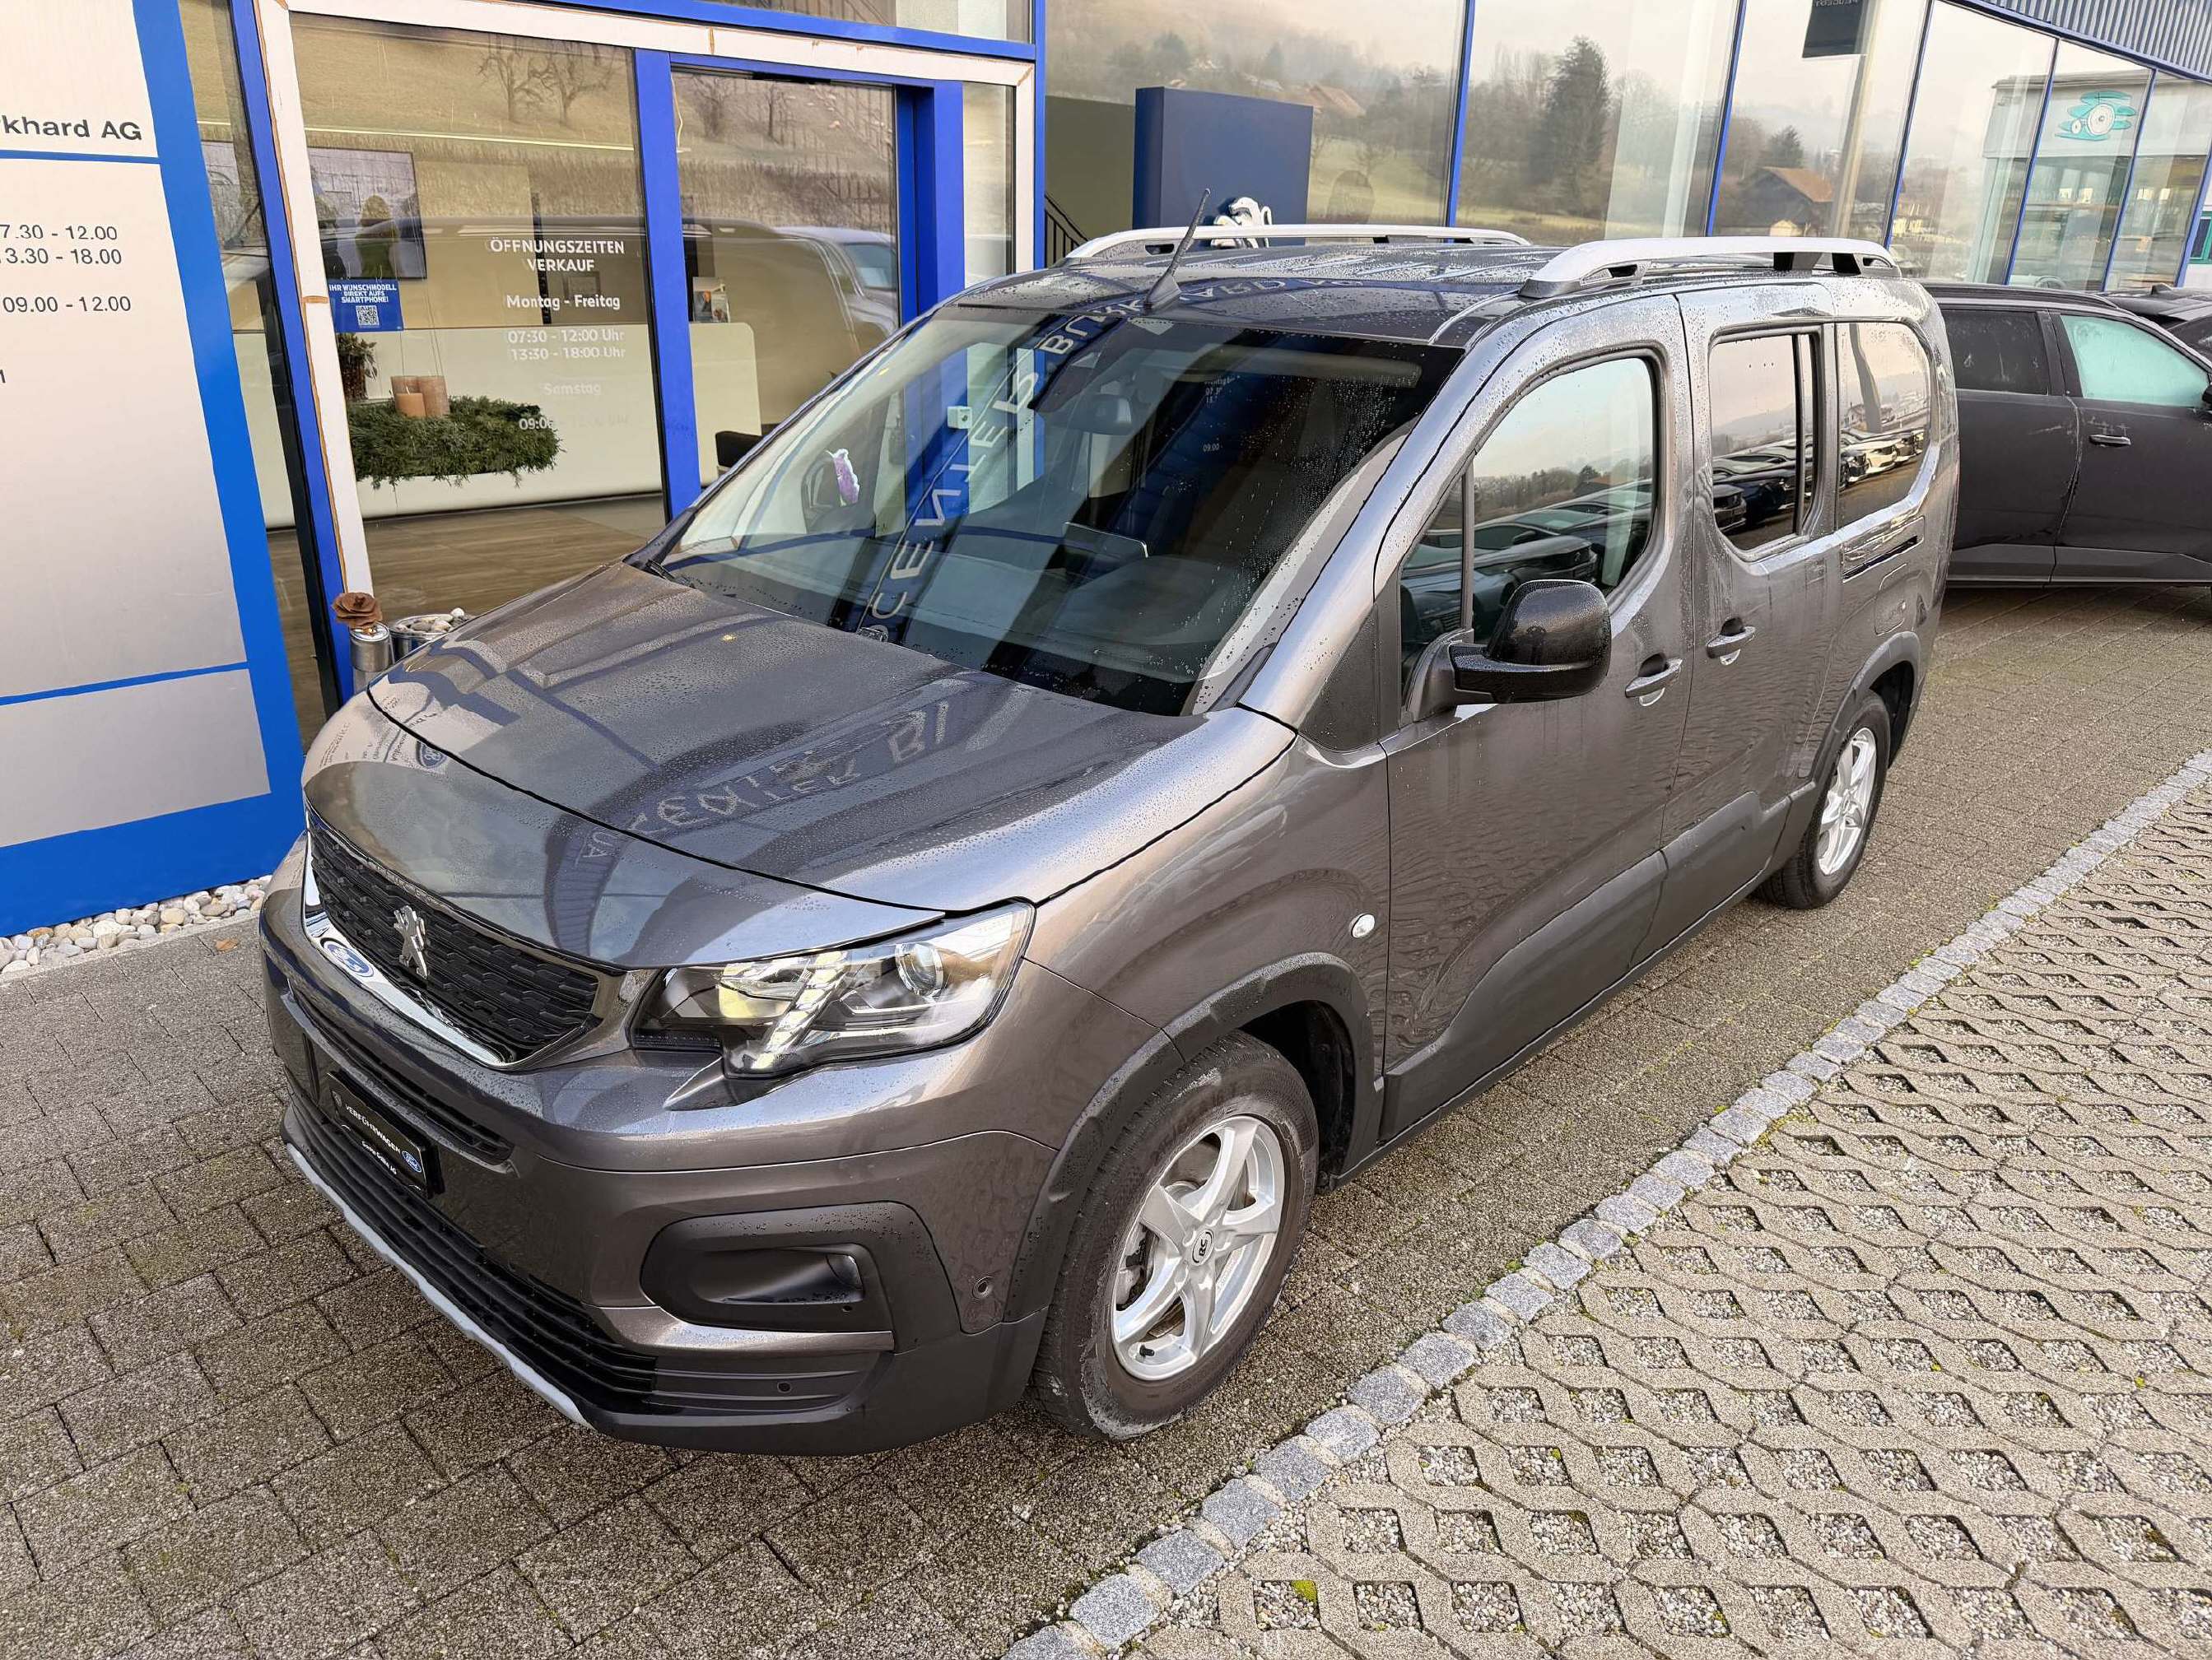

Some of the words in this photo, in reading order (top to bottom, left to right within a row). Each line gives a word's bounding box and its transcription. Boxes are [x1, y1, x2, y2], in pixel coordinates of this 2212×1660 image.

[0, 115, 90, 137] khard
[101, 121, 142, 140] AG
[65, 226, 118, 240] 12.00
[490, 237, 625, 254] ÖFFNUNGSZEITEN
[0, 248, 49, 264] 3.30
[70, 249, 122, 264] 18.00
[527, 258, 595, 272] VERKAUF
[2, 296, 58, 313] 09.00
[79, 295, 132, 312] 12.00
[506, 295, 561, 310] Montag
[574, 294, 621, 309] Freitag
[507, 330, 547, 343] 07:30
[561, 329, 598, 342] 12:00
[602, 329, 625, 341] Uhr
[510, 348, 549, 360] 13:30
[562, 346, 600, 359] 18:00
[603, 346, 626, 357] Uhr
[542, 382, 601, 396] Samstag
